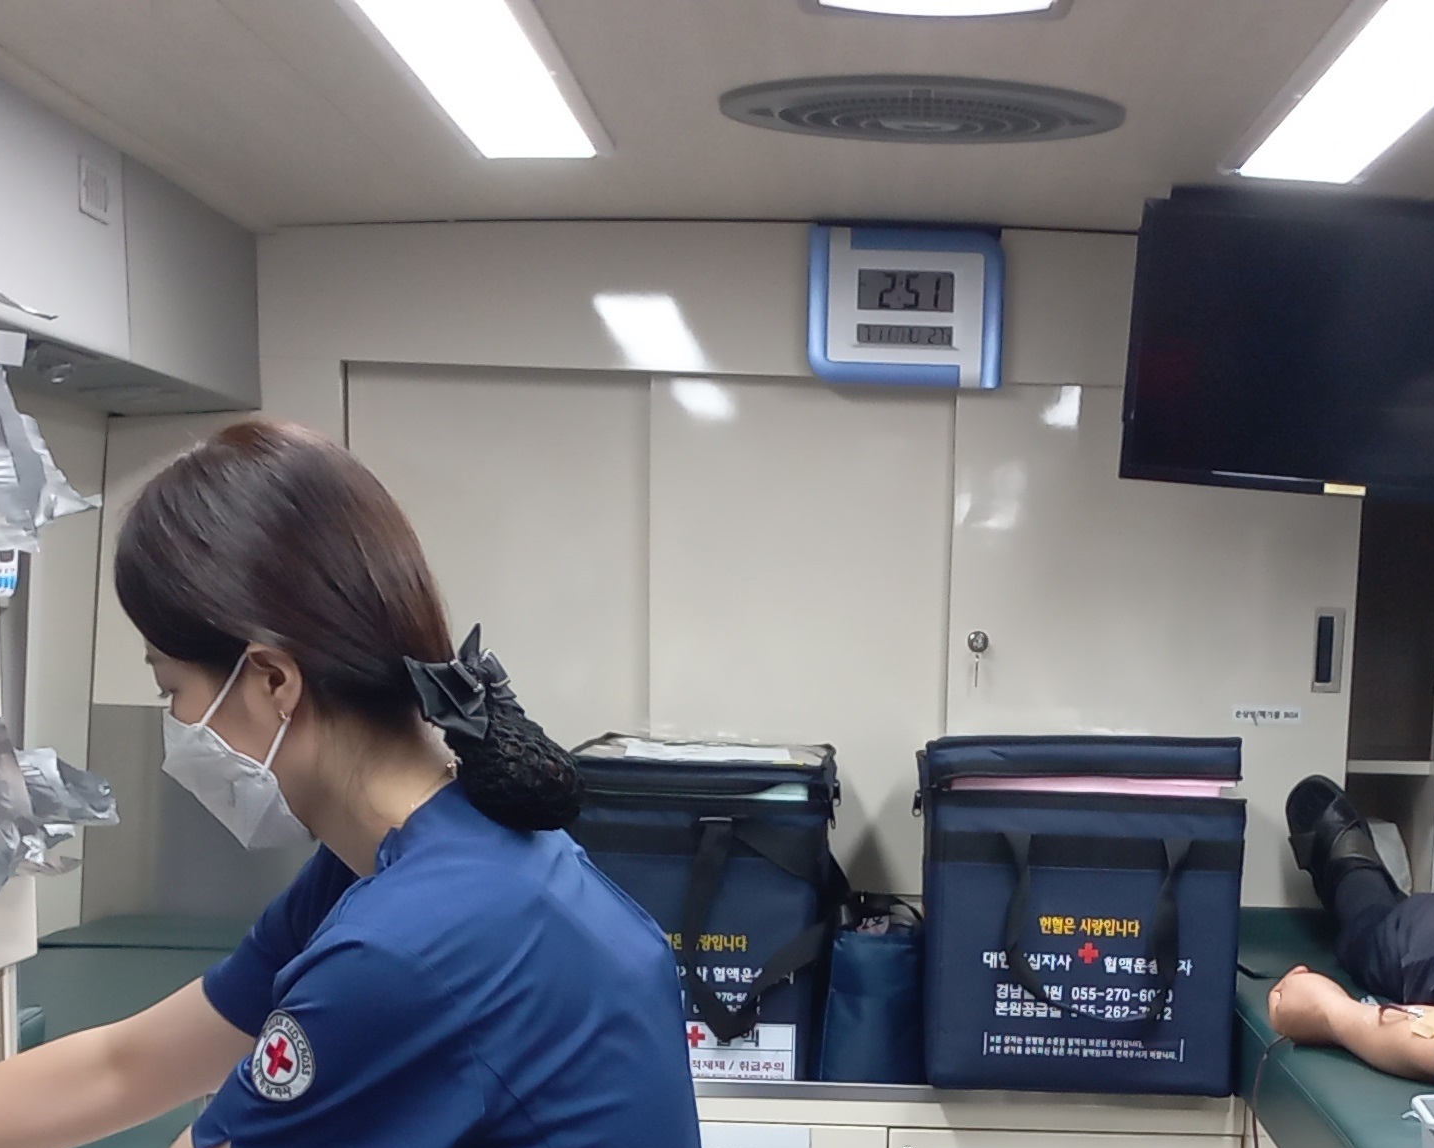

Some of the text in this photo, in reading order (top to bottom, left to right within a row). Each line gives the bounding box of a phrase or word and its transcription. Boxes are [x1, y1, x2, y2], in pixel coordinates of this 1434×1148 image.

[1038, 914, 1142, 938] 헌혈은 사랑입니다
[296, 1040, 312, 1077] CROSS
